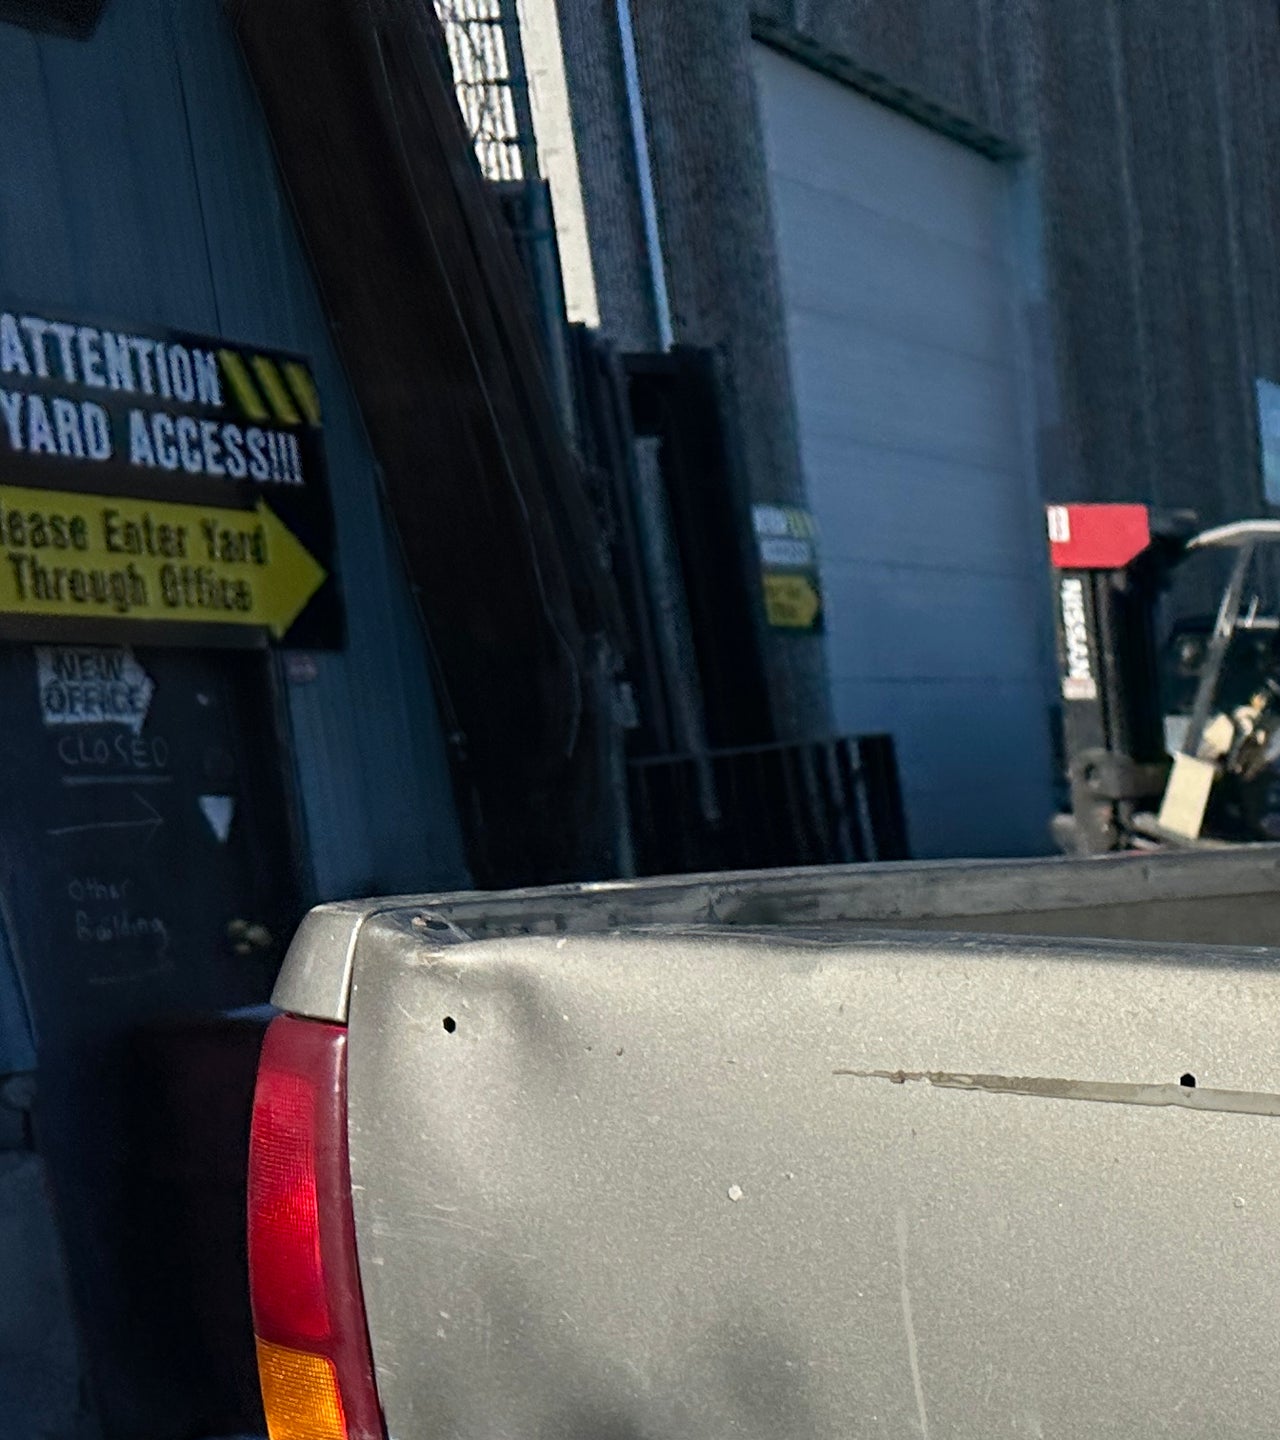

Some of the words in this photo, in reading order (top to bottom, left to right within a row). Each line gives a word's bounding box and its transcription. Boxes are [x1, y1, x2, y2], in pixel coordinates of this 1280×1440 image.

[0, 313, 223, 407] ATTENTION
[0, 388, 113, 461] YARD
[129, 408, 304, 486] ACCESS!!!
[8, 551, 148, 613] Through
[160, 562, 252, 612] Office
[101, 507, 188, 558] Enter
[200, 516, 268, 566] Yard
[1061, 577, 1091, 681] NISSAN
